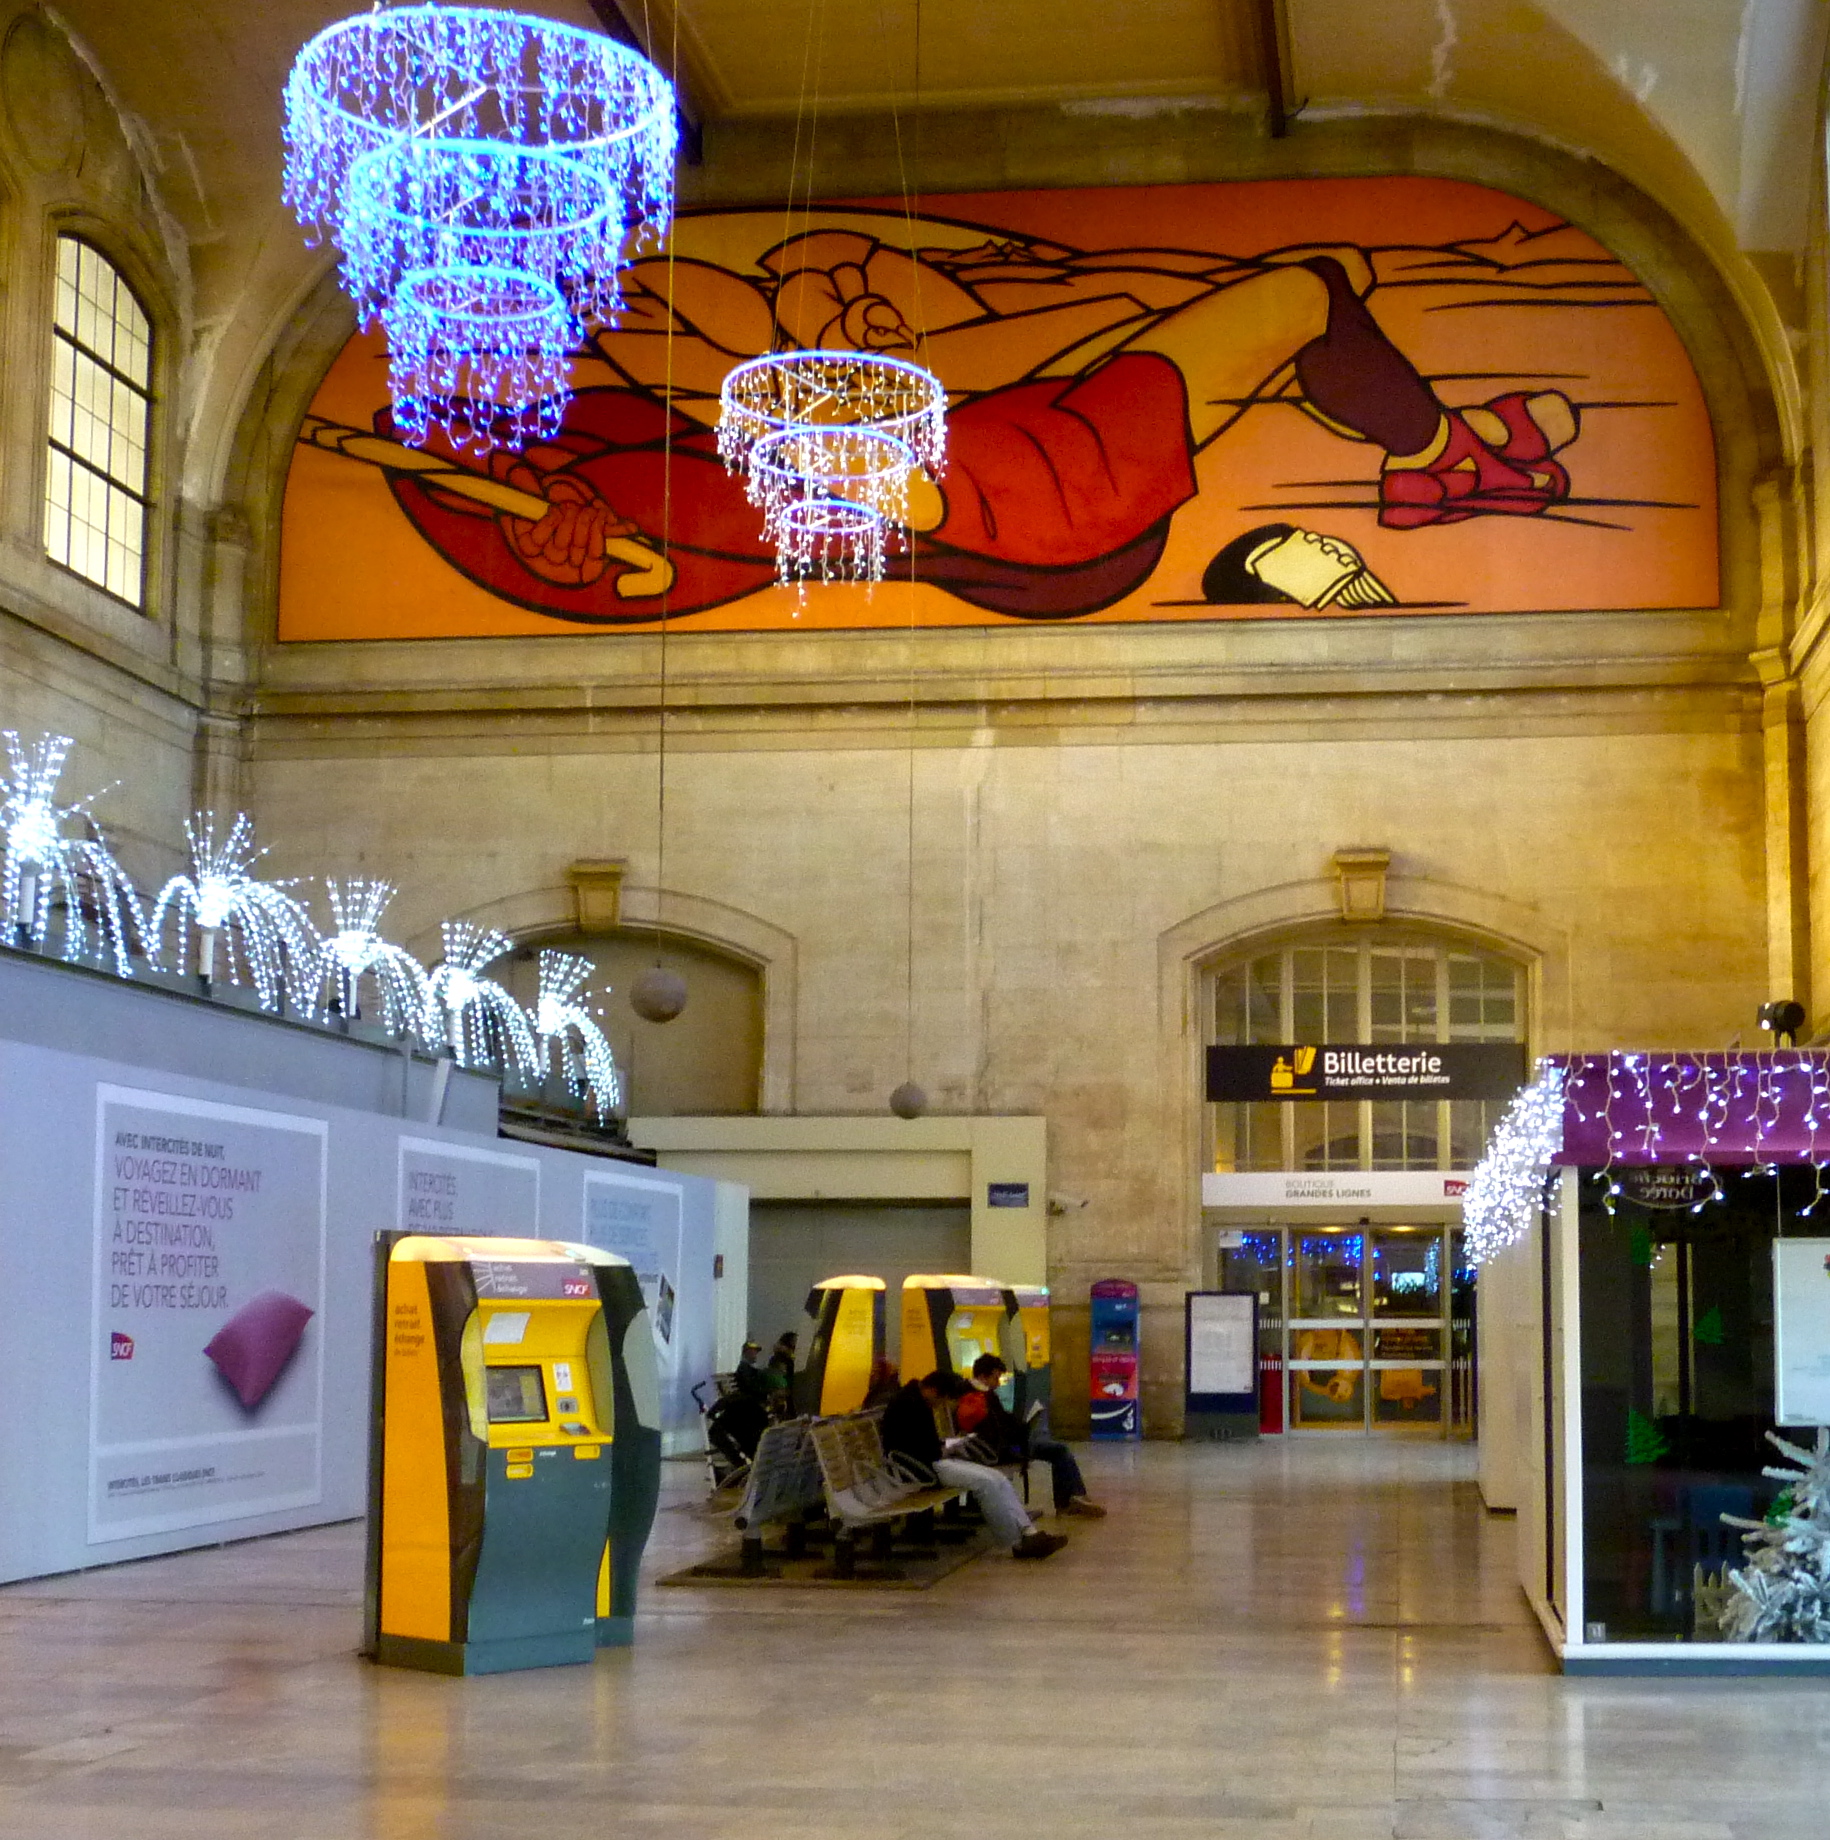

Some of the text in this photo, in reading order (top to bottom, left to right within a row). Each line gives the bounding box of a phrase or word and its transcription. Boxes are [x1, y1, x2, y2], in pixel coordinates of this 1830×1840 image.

[1324, 1051, 1442, 1074] Billetterie
[1325, 1076, 1349, 1086] Ticket
[1350, 1076, 1374, 1086] office
[1381, 1075, 1406, 1086] Venta
[1408, 1075, 1419, 1085] de
[115, 1132, 138, 1149] AVEC
[141, 1135, 189, 1156] INTERCITÉS
[191, 1142, 203, 1157] DE
[115, 1155, 262, 1193] VOYAGEZ EN DORMANT
[1285, 1180, 1334, 1188] BOUTIQUE
[113, 1186, 234, 1220] ET RÉVEILLEZ-VOUS
[1285, 1188, 1372, 1198] GRANDES LIGNES
[112, 1215, 216, 1251] À DESTINATION,
[111, 1247, 220, 1278] PRÊT À PROFITER
[111, 1280, 229, 1308] DE VOTRE SÉJOUR.
[563, 1283, 589, 1295] SNCF
[111, 1342, 133, 1357] SNCF
